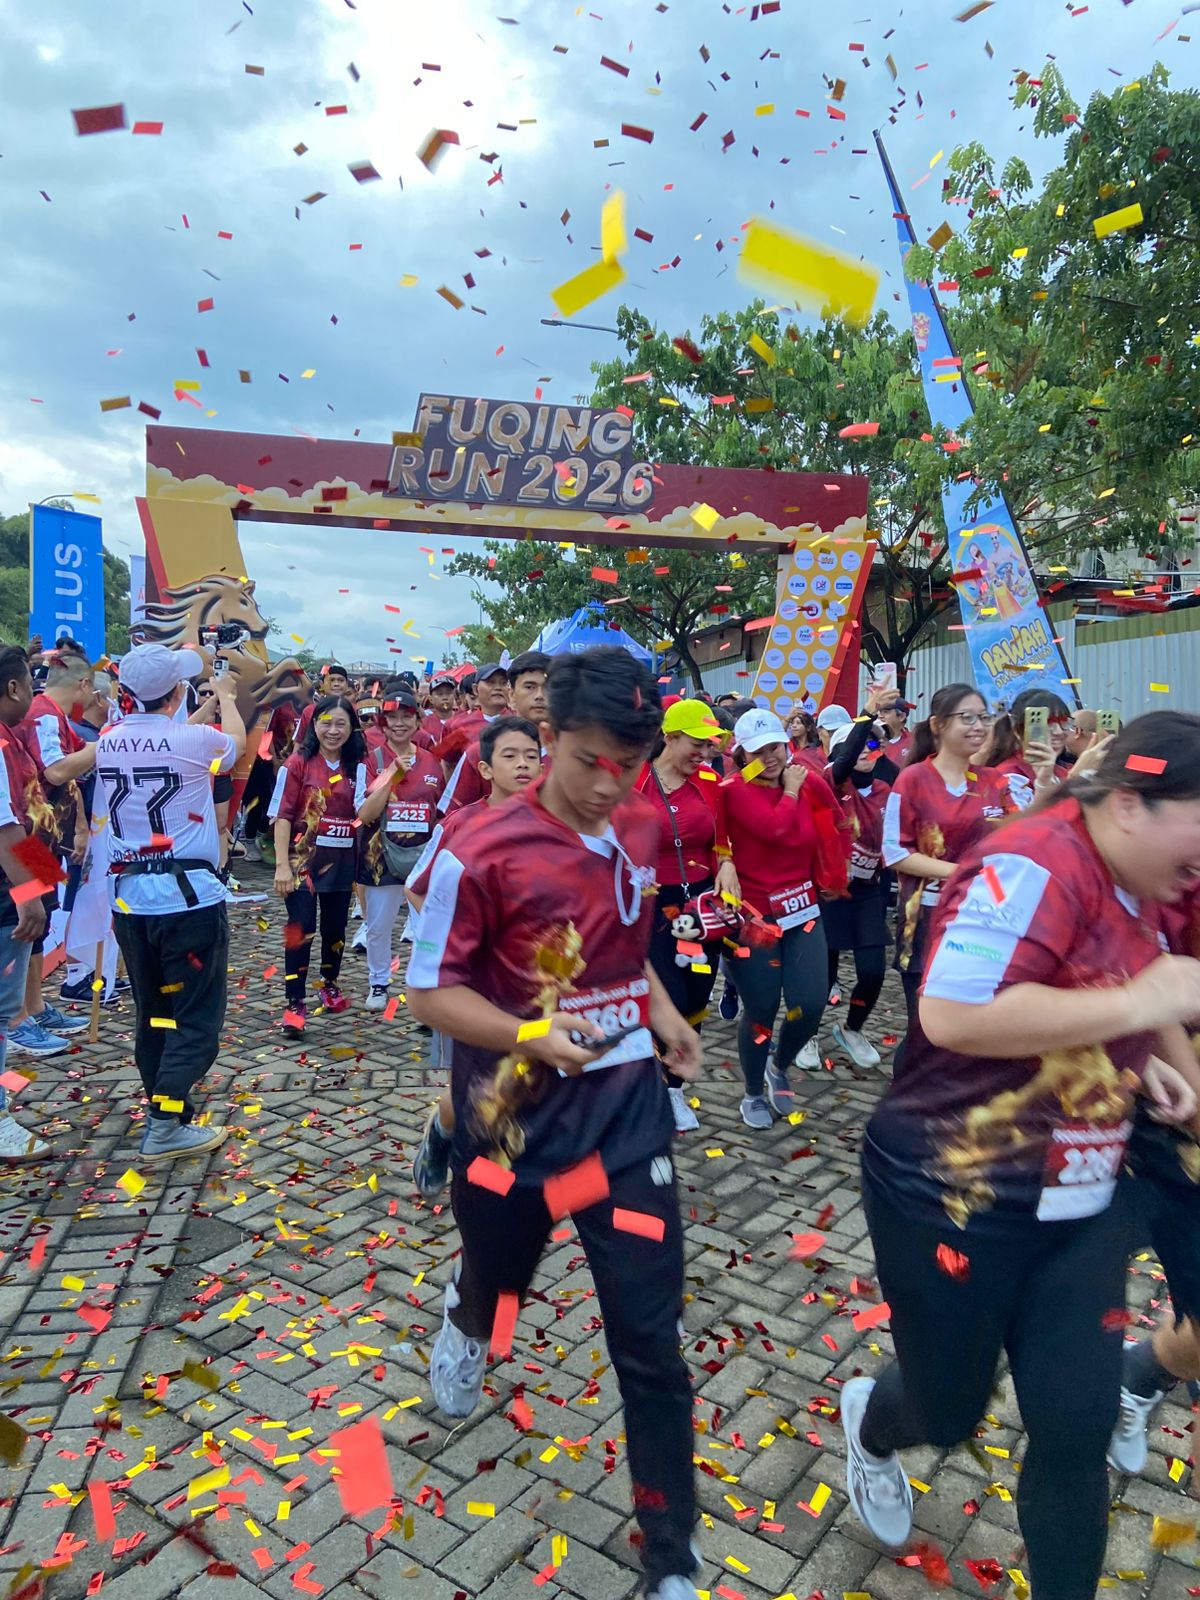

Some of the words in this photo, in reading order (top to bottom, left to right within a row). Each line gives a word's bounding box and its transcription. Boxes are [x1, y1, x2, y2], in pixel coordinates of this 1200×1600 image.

[414, 396, 632, 457] FUQING
[388, 445, 509, 500] RUN
[517, 454, 655, 509] 2026
[98, 766, 184, 841] 77
[392, 809, 426, 822] 2423
[326, 824, 351, 837] 2111
[781, 892, 811, 914] 1911
